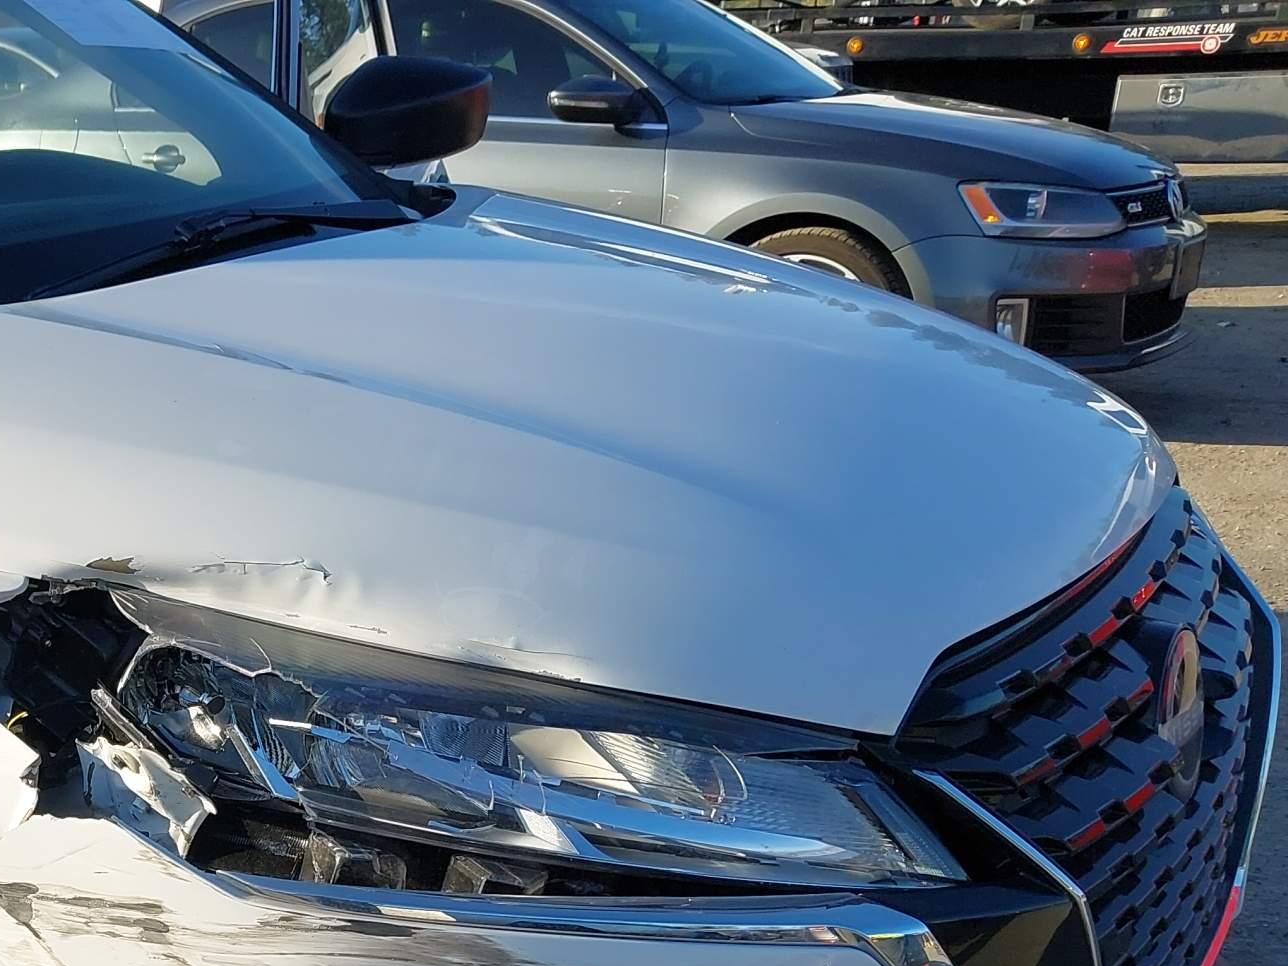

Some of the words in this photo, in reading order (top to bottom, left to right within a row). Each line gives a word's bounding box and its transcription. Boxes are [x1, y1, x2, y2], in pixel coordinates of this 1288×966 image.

[1123, 27, 1146, 38] CAT
[1147, 24, 1201, 37] RESPONSE
[1203, 23, 1236, 34] TEAM
